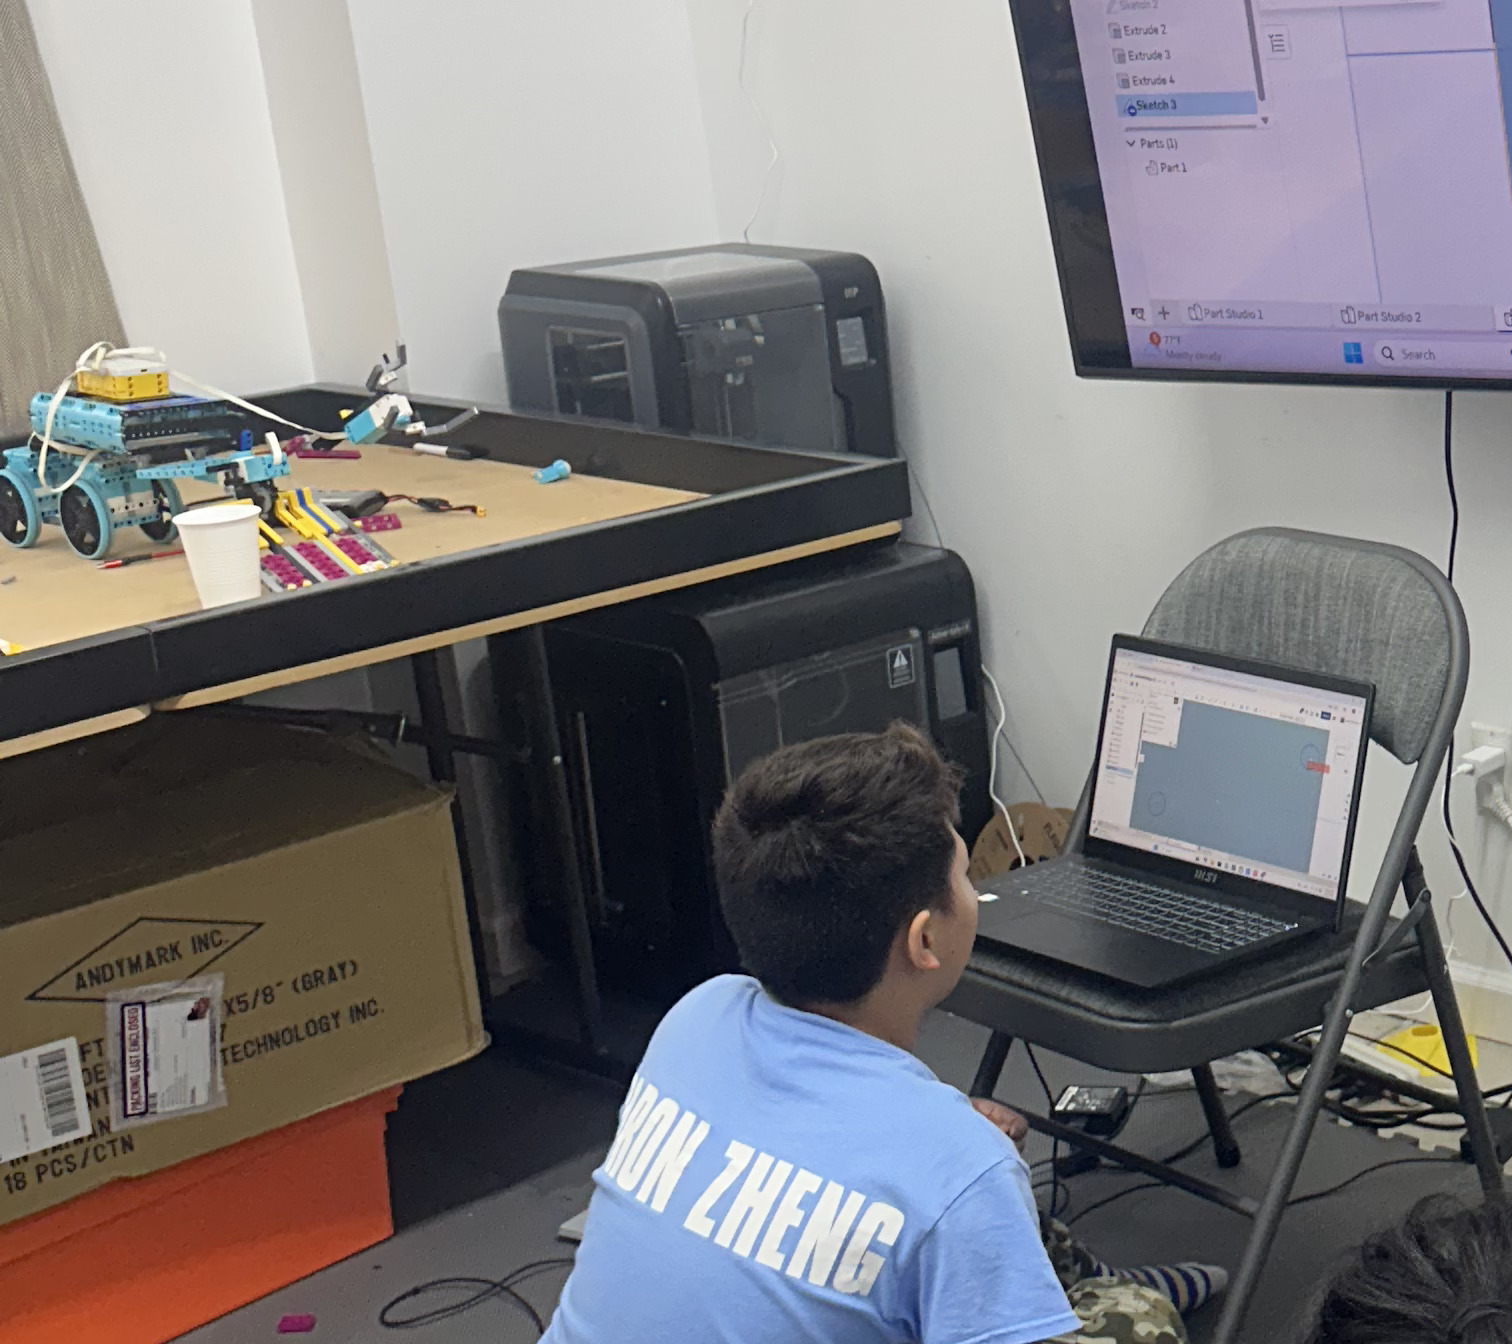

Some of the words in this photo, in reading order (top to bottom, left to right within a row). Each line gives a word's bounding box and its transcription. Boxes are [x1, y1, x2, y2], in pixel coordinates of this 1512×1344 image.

[1123, 25, 1159, 36] Extrude
[1128, 50, 1163, 61] Extrude
[1132, 75, 1167, 86] Extrude
[1136, 99, 1169, 111] Sketch
[1140, 138, 1164, 149] Parts
[1160, 162, 1181, 173] Part
[1203, 307, 1224, 319] Part
[1357, 312, 1379, 322] Part
[1381, 312, 1413, 323] Studio
[1401, 349, 1436, 361] Search
[75, 941, 182, 991] ANDYMARK
[191, 929, 230, 954] INC.
[292, 960, 358, 994] (GRAY)
[220, 1009, 340, 1067] TECHNOLOGY
[349, 995, 385, 1024] INC.
[128, 1055, 141, 1074] LIST
[4, 1171, 27, 1194] 18
[35, 1134, 135, 1184] PCS/CTN
[683, 1139, 905, 1297] ZHENG
